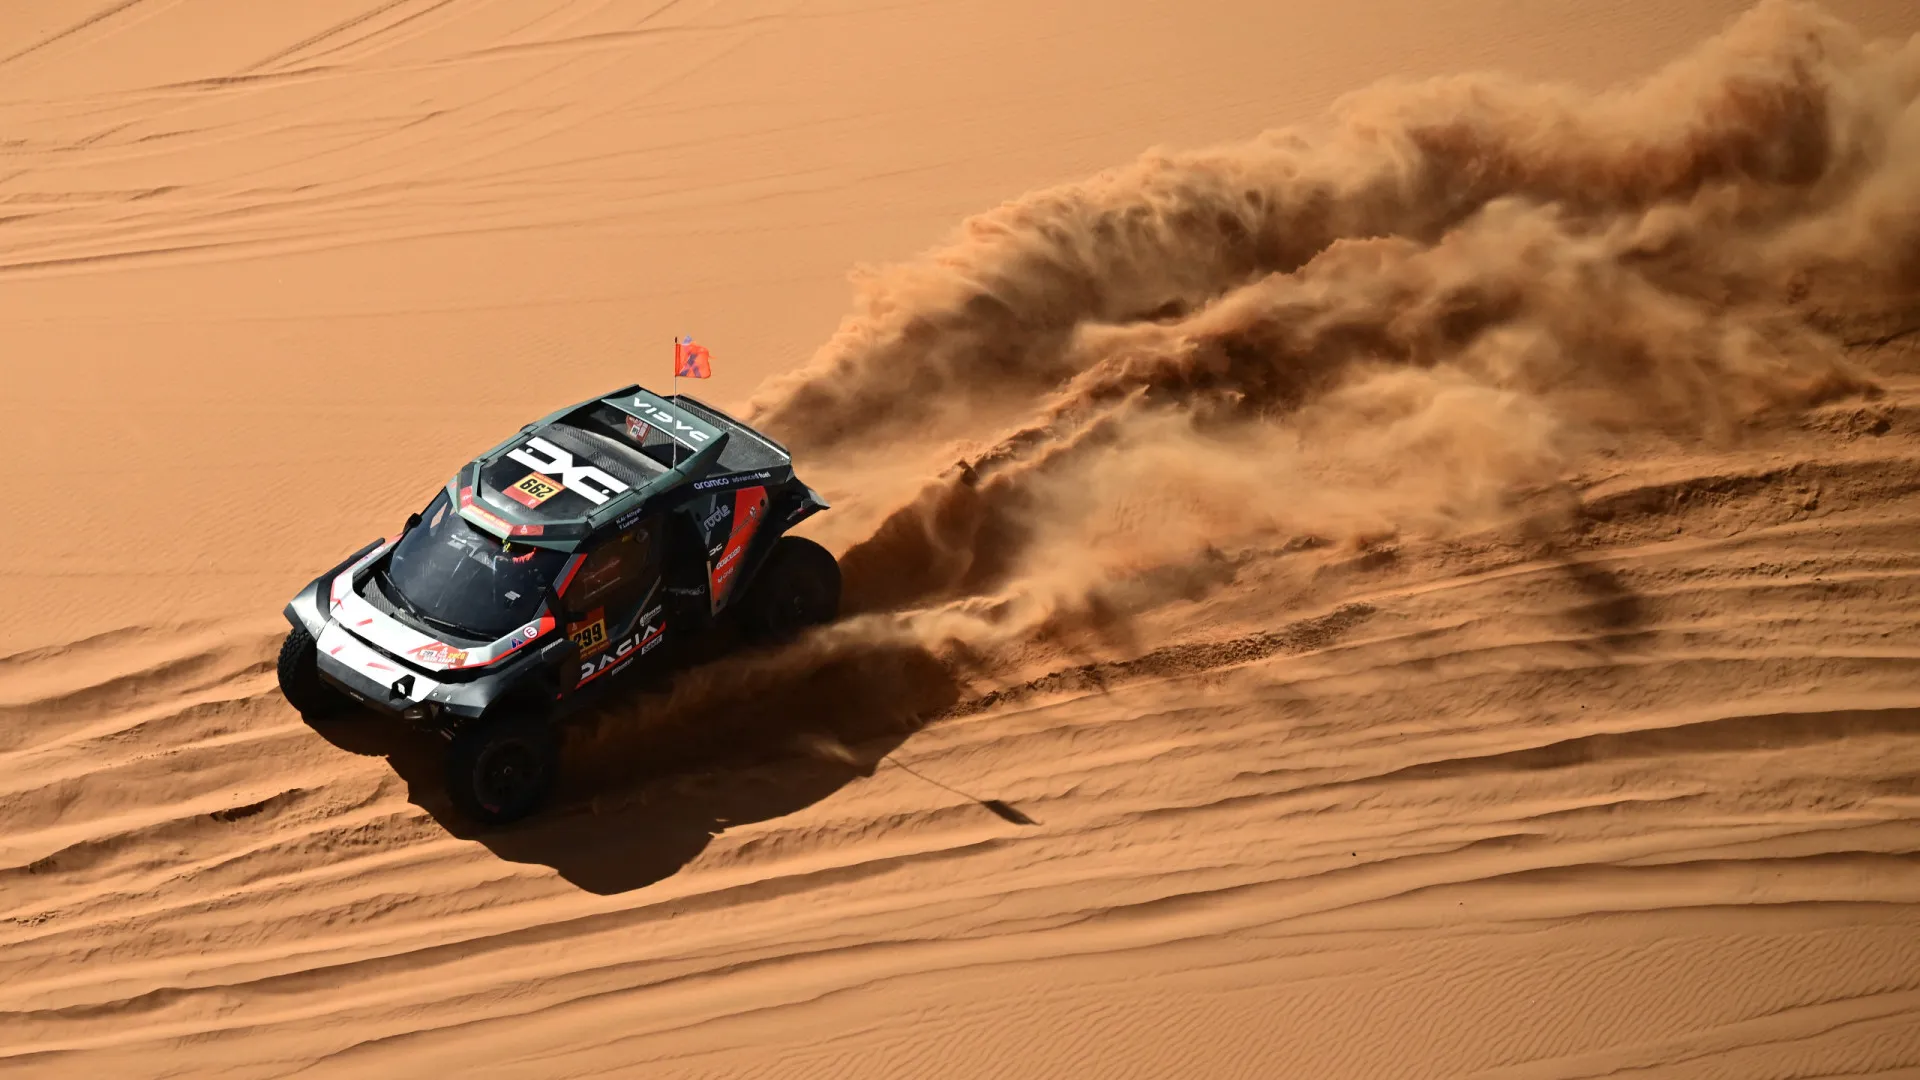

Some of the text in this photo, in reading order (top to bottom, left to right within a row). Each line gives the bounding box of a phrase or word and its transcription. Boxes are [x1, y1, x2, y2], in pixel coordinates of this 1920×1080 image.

[633, 397, 710, 442] DACIA
[519, 476, 554, 500] 299
[693, 471, 771, 490] aramco advanced fuel
[573, 622, 603, 650] 299
[580, 625, 658, 681] DACIA
